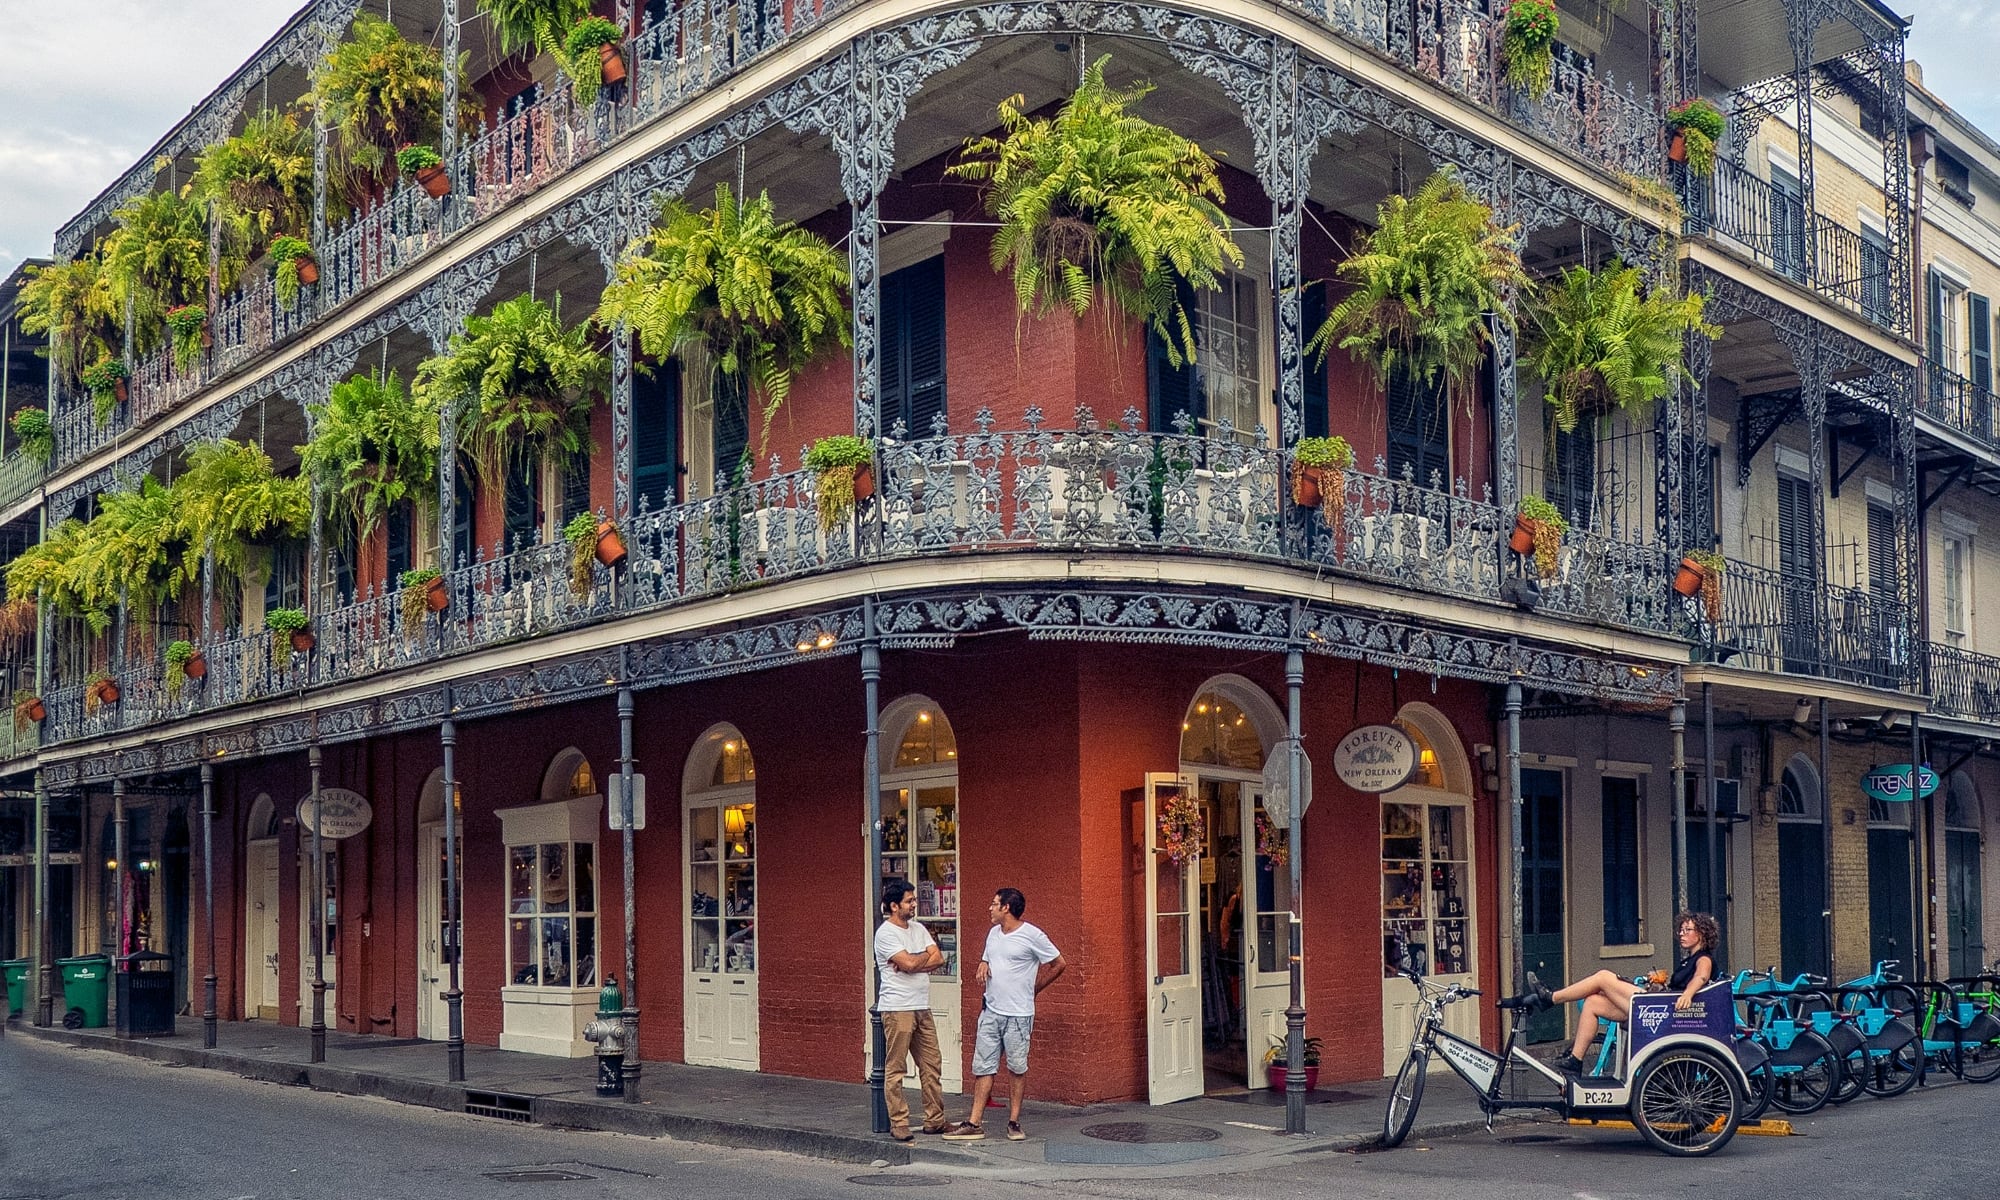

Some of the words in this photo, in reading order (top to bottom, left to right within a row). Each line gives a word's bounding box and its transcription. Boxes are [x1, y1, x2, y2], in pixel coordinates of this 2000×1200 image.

[1344, 731, 1402, 754] FOREVER
[1344, 769, 1361, 777] NEW
[1365, 768, 1402, 777] ORLEANS
[311, 792, 363, 809] OREVER
[1638, 1005, 1669, 1019] Vintage
[1449, 1042, 1464, 1052] NEED
[1584, 1092, 1613, 1104] PC-22
